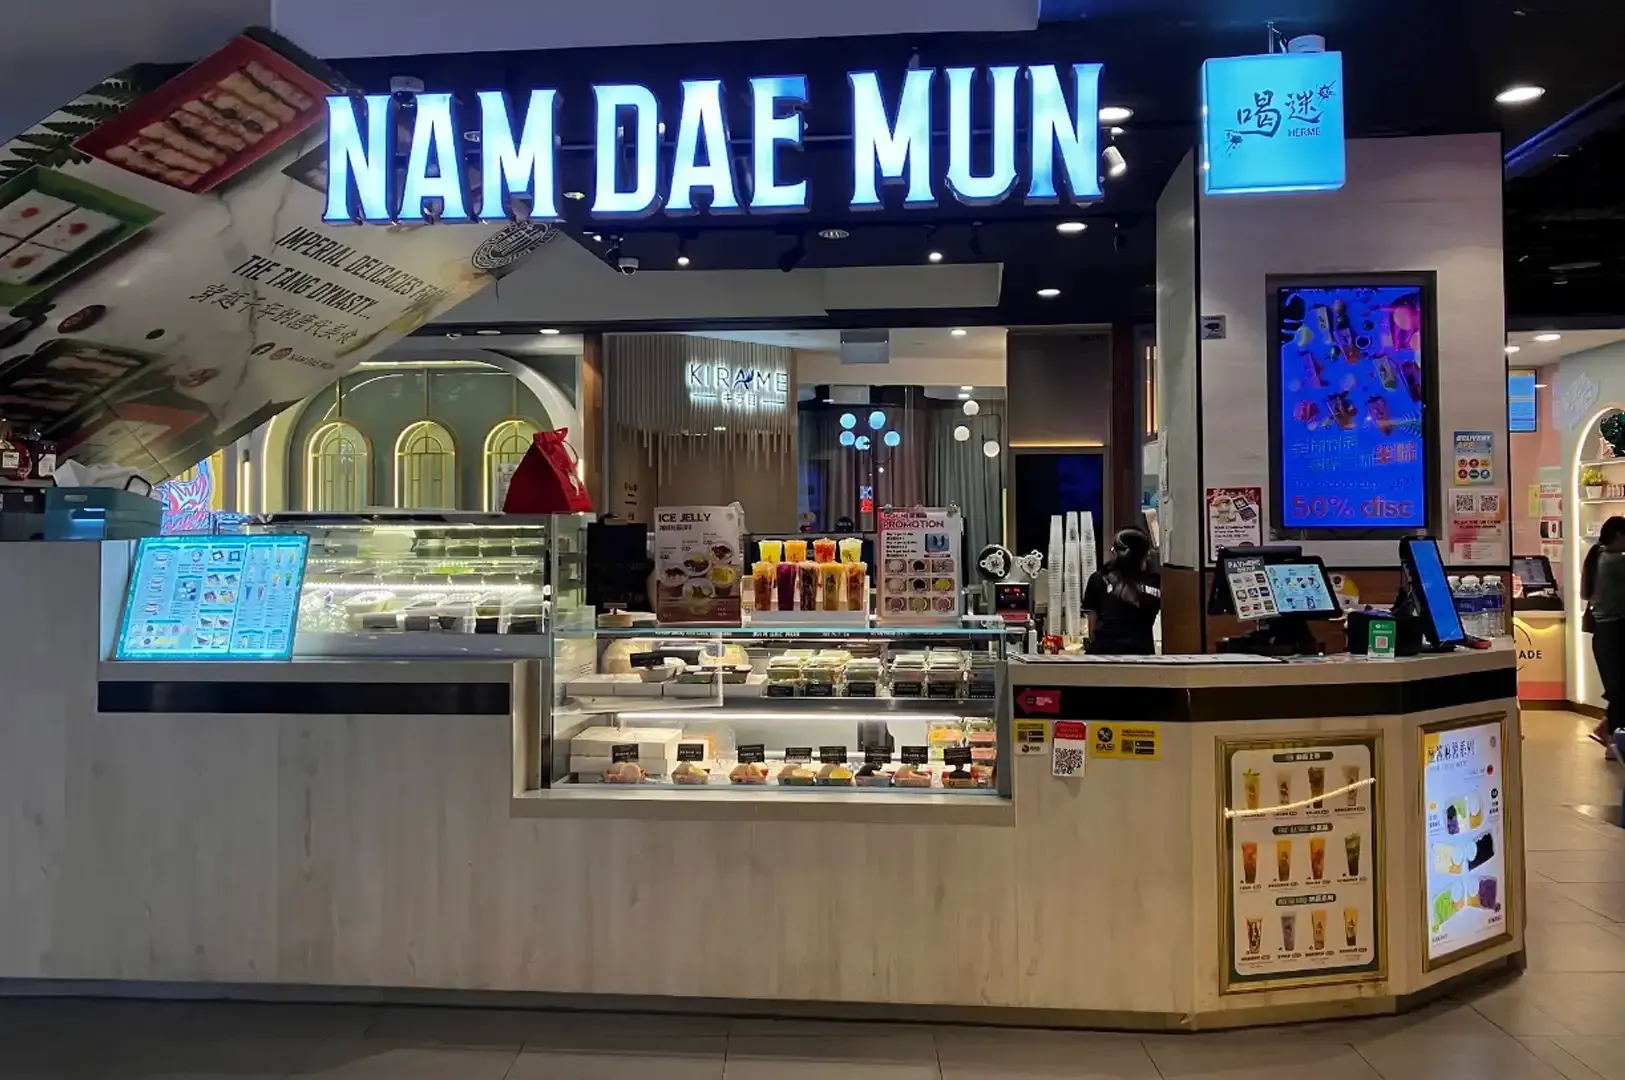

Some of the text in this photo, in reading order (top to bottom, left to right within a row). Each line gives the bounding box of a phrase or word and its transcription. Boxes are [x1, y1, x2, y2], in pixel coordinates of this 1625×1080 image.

[1234, 89, 1325, 138] 喝迷
[323, 63, 1105, 221] NAM DAE MUN
[1288, 127, 1320, 137] HERME
[231, 254, 281, 281] THE
[265, 265, 321, 295] TANG
[275, 225, 357, 268] IMPERIAL
[342, 254, 424, 296] DELICACIES
[659, 513, 711, 522] ICE JELLY
[1293, 496, 1415, 519] 50% disc
[883, 520, 944, 529] PROMOTION
